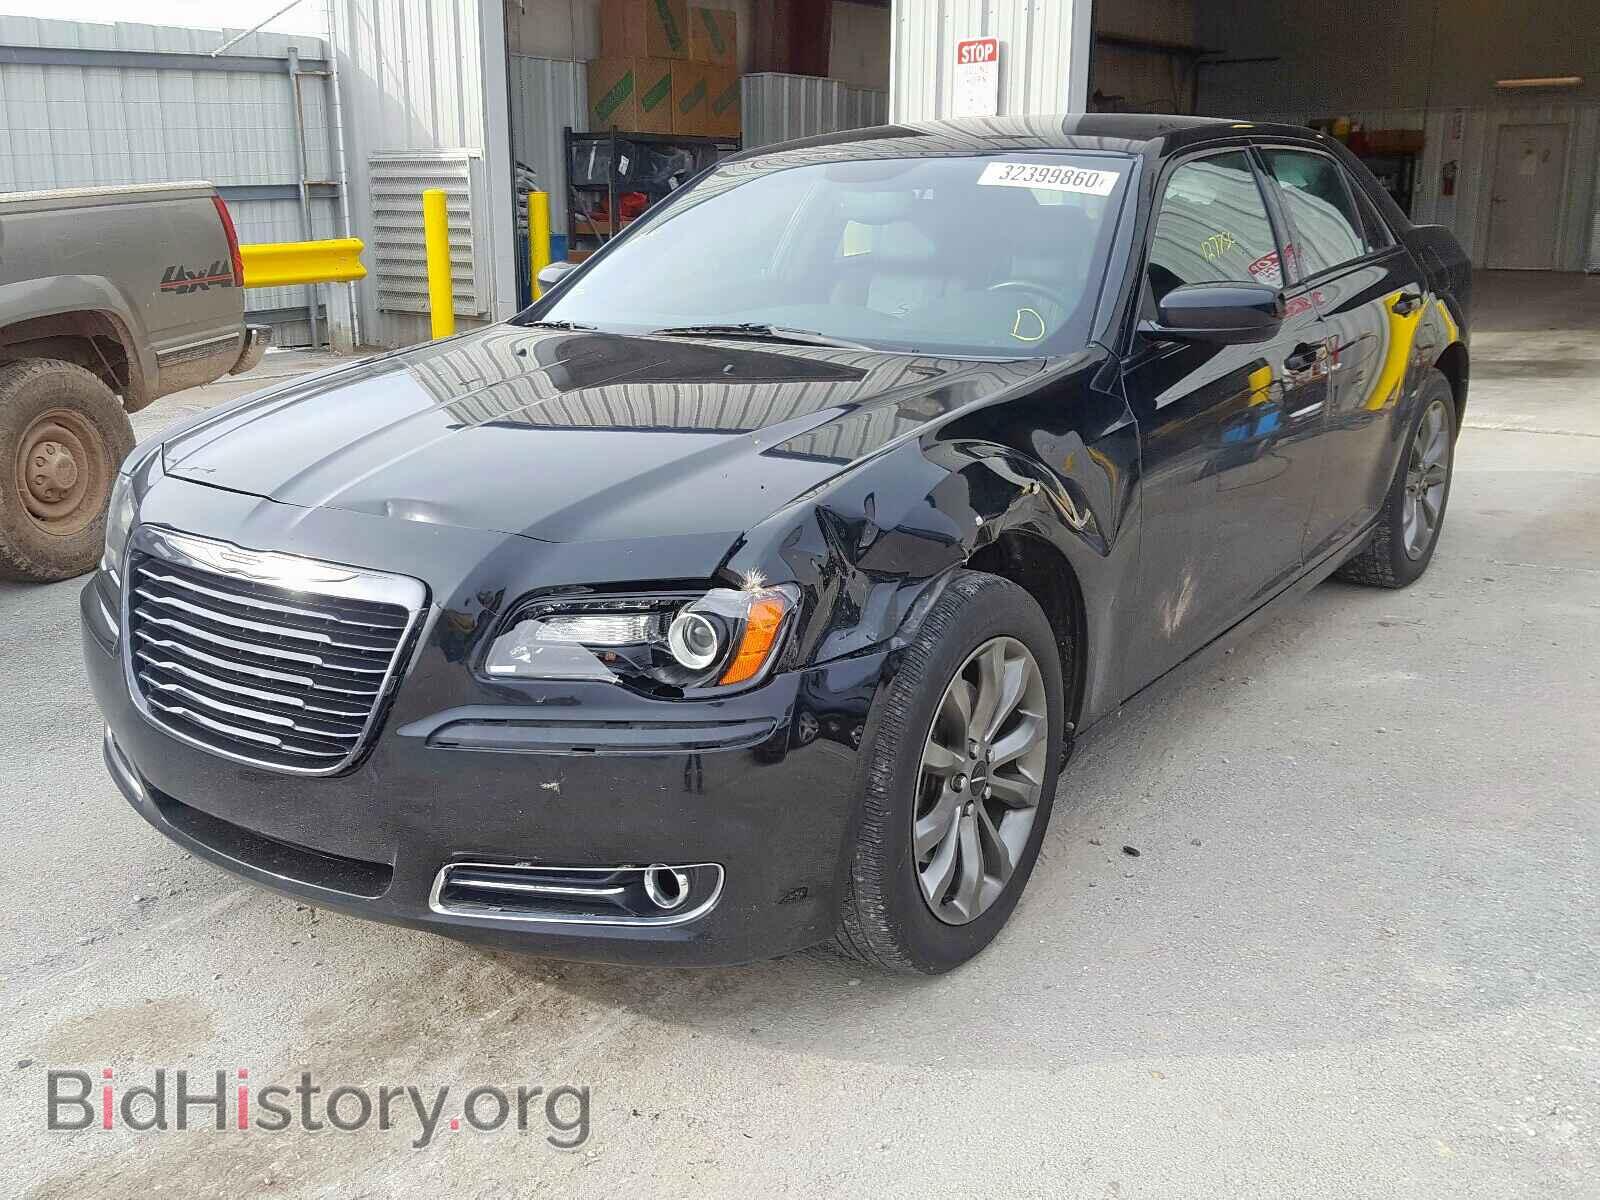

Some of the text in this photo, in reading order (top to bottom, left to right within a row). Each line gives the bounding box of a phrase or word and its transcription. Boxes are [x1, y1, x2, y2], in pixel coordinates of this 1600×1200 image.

[961, 43, 994, 64] STOP
[999, 164, 1100, 188] 32399860
[160, 259, 233, 294] 4x4
[1010, 308, 1045, 341] D
